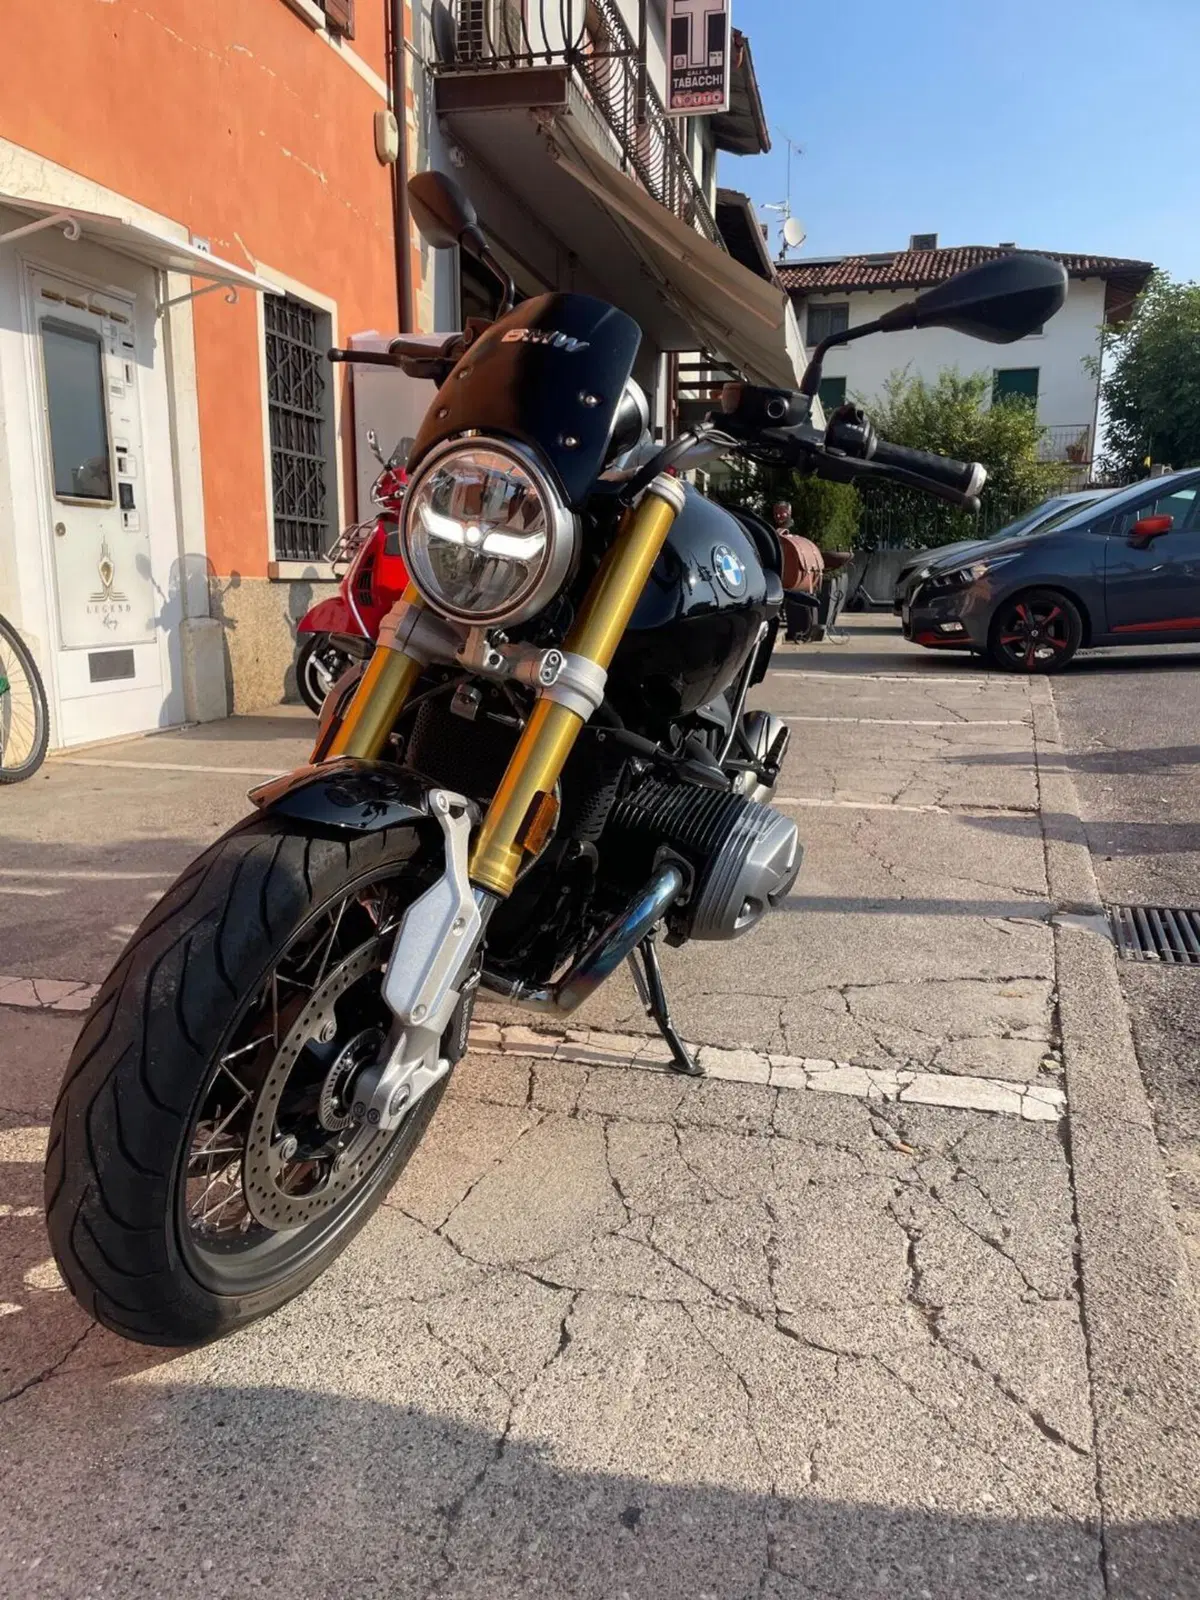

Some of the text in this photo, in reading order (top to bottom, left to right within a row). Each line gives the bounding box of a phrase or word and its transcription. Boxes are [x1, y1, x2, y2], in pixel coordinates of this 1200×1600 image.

[672, 74, 723, 89] TABACCHI
[501, 328, 590, 352] BMW
[86, 604, 131, 614] LEGEND
